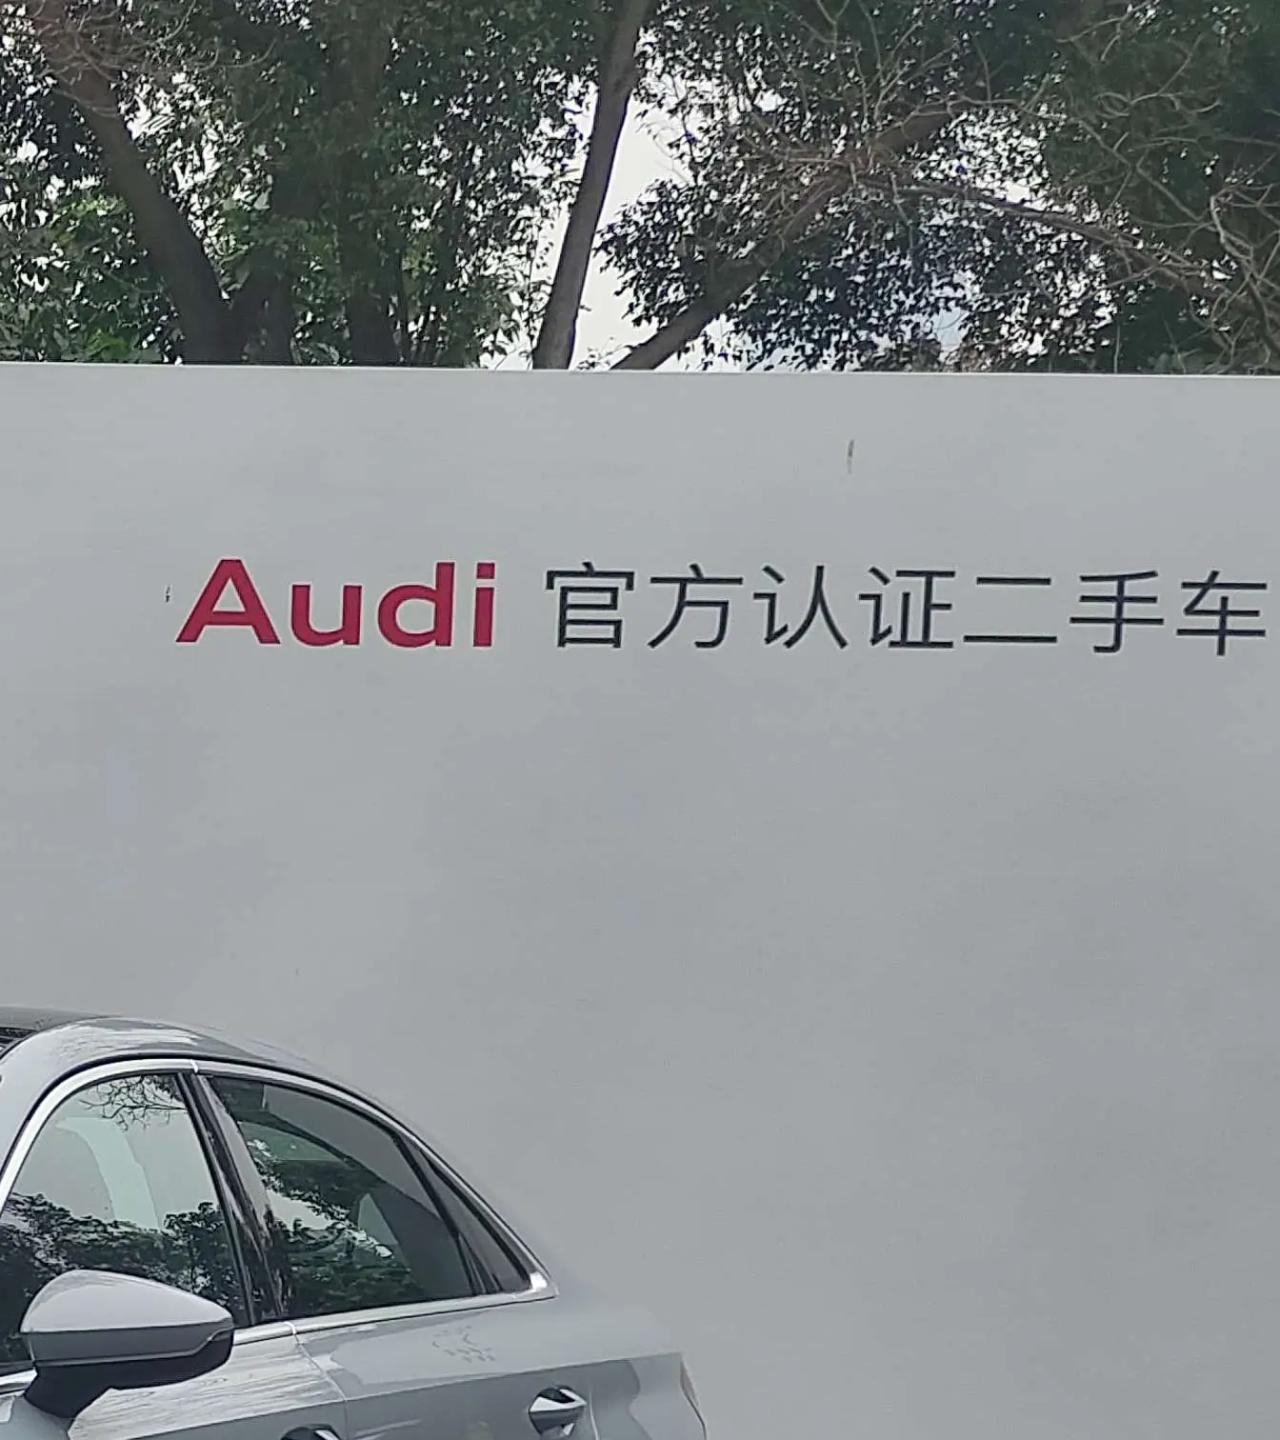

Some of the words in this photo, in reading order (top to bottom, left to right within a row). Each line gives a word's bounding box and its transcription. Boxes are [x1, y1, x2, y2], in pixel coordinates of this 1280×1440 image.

[176, 558, 494, 647] Audi
[545, 561, 1268, 656] 官方认证二手车
